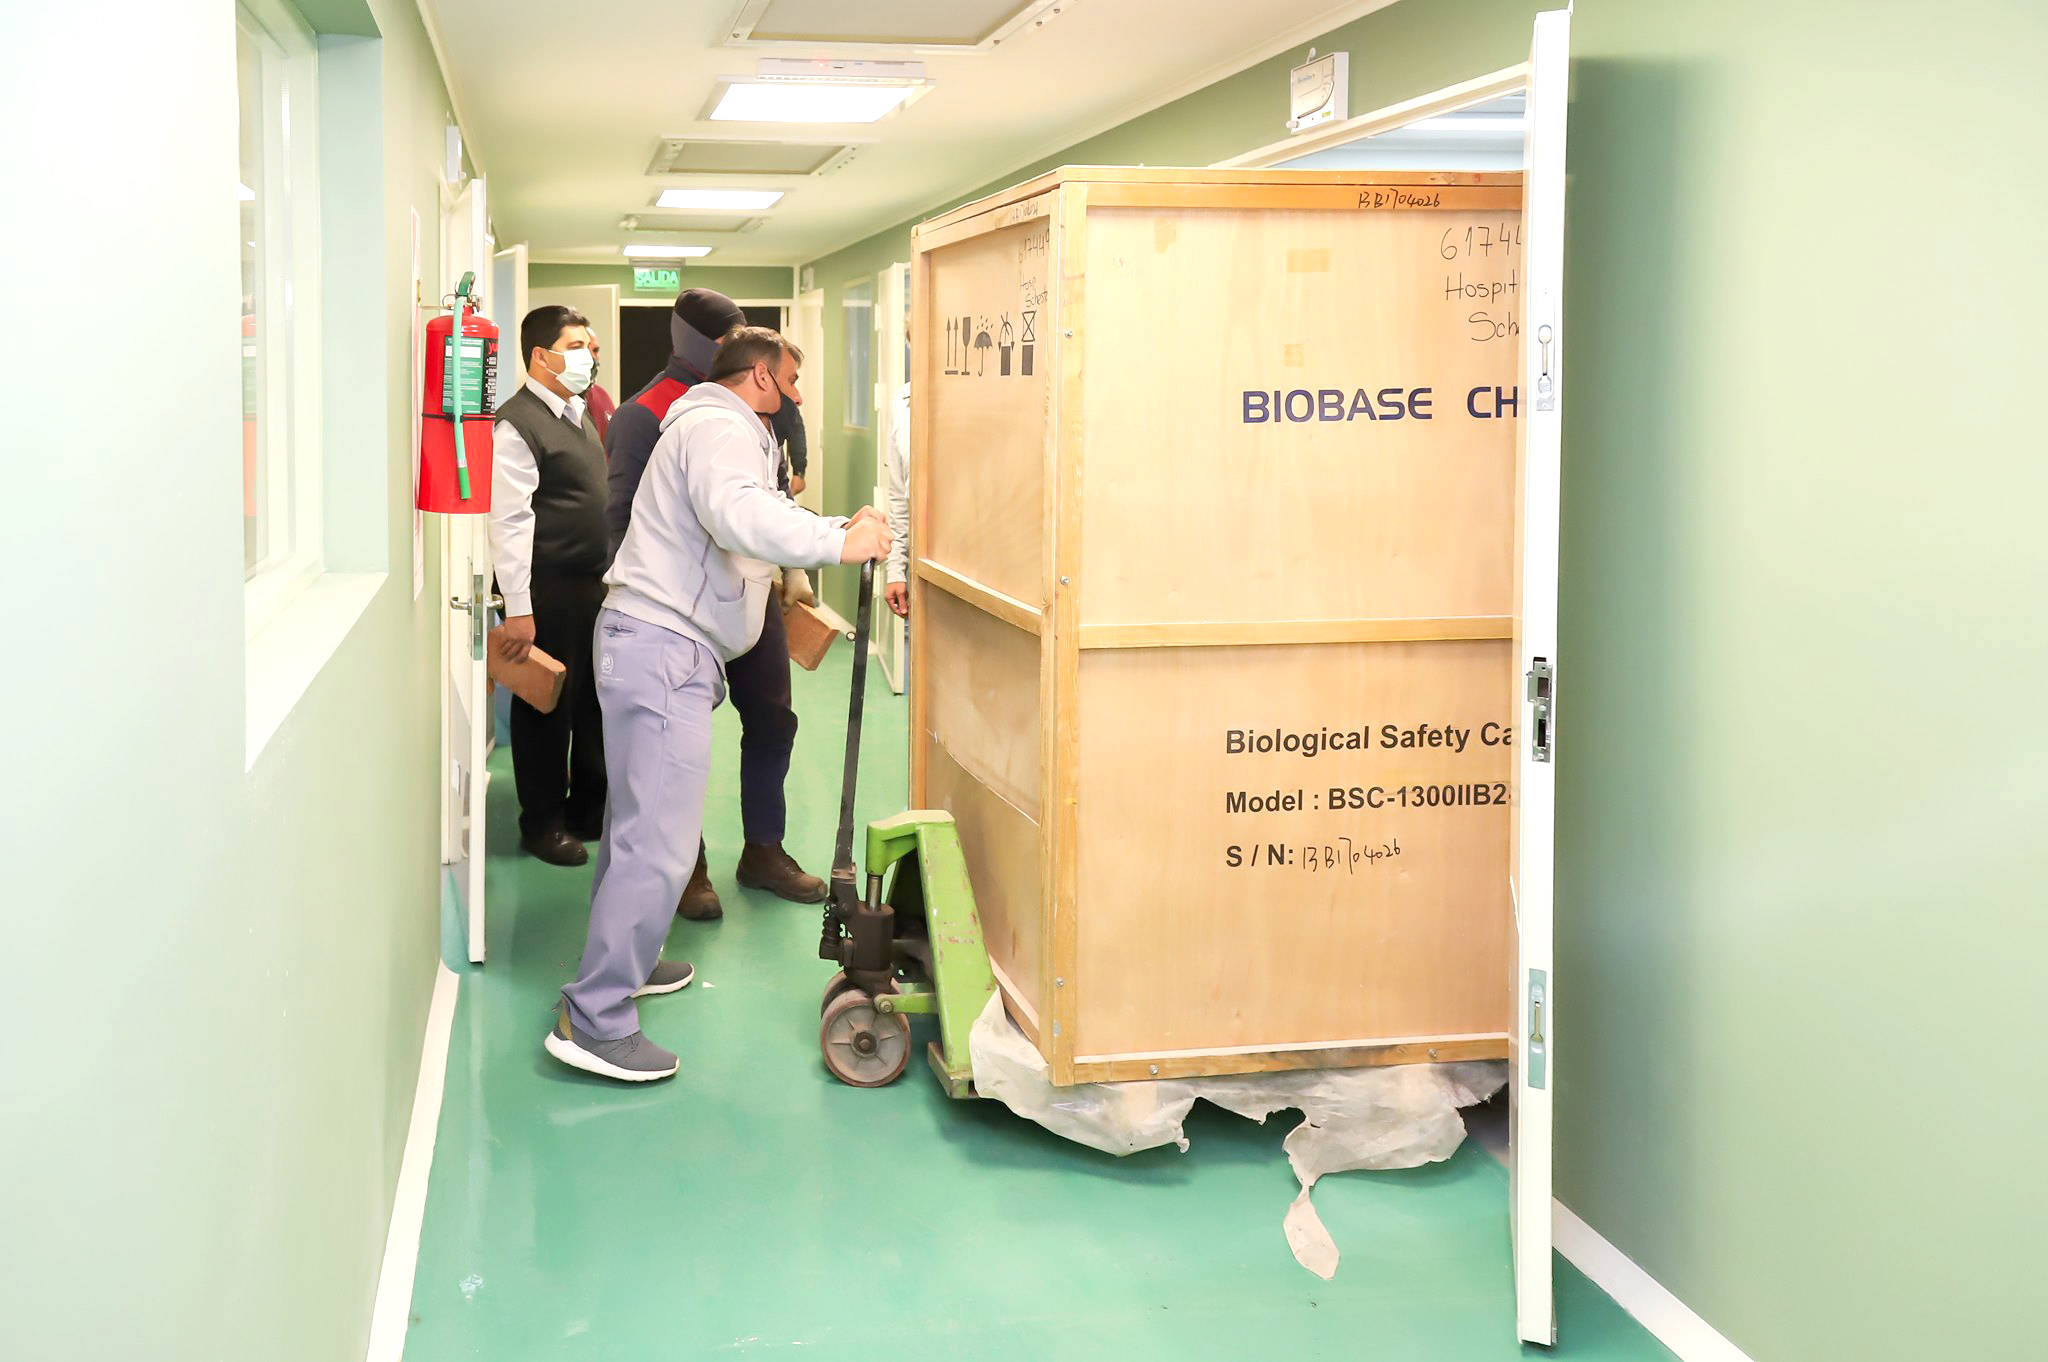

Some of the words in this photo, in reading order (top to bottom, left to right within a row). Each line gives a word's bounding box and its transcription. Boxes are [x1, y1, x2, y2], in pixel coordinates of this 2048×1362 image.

[634, 270, 680, 287] SALIDA
[1243, 387, 1432, 423] BIOBASE
[1467, 386, 1518, 418] CH
[1226, 725, 1370, 758] Biological
[1380, 723, 1471, 753] Safety
[1226, 789, 1303, 813] Model
